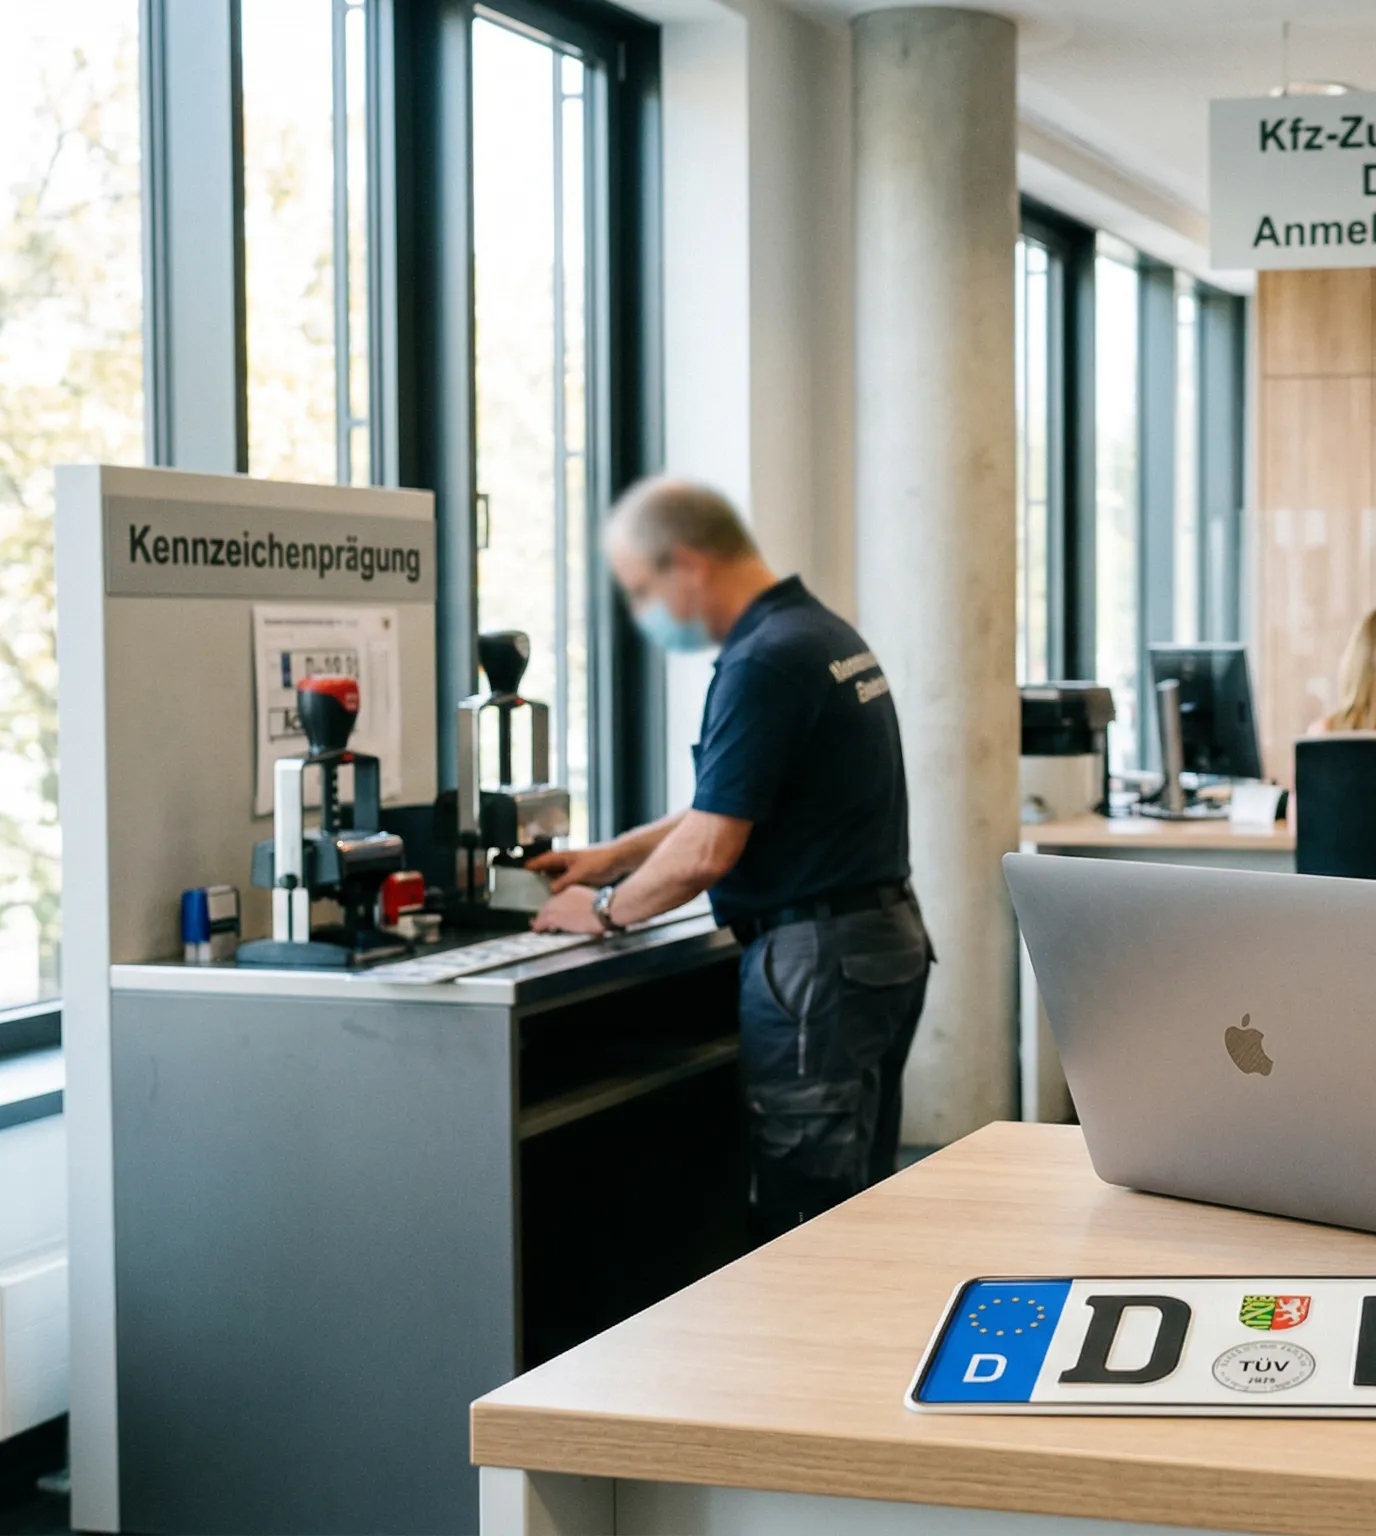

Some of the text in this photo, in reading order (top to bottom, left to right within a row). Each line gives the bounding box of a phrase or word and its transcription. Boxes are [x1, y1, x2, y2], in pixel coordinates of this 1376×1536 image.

[129, 523, 421, 584] Kennzeichenprägung
[1058, 1294, 1193, 1386] D
[962, 1353, 1008, 1384] D
[1239, 1357, 1290, 1372] TÜV
